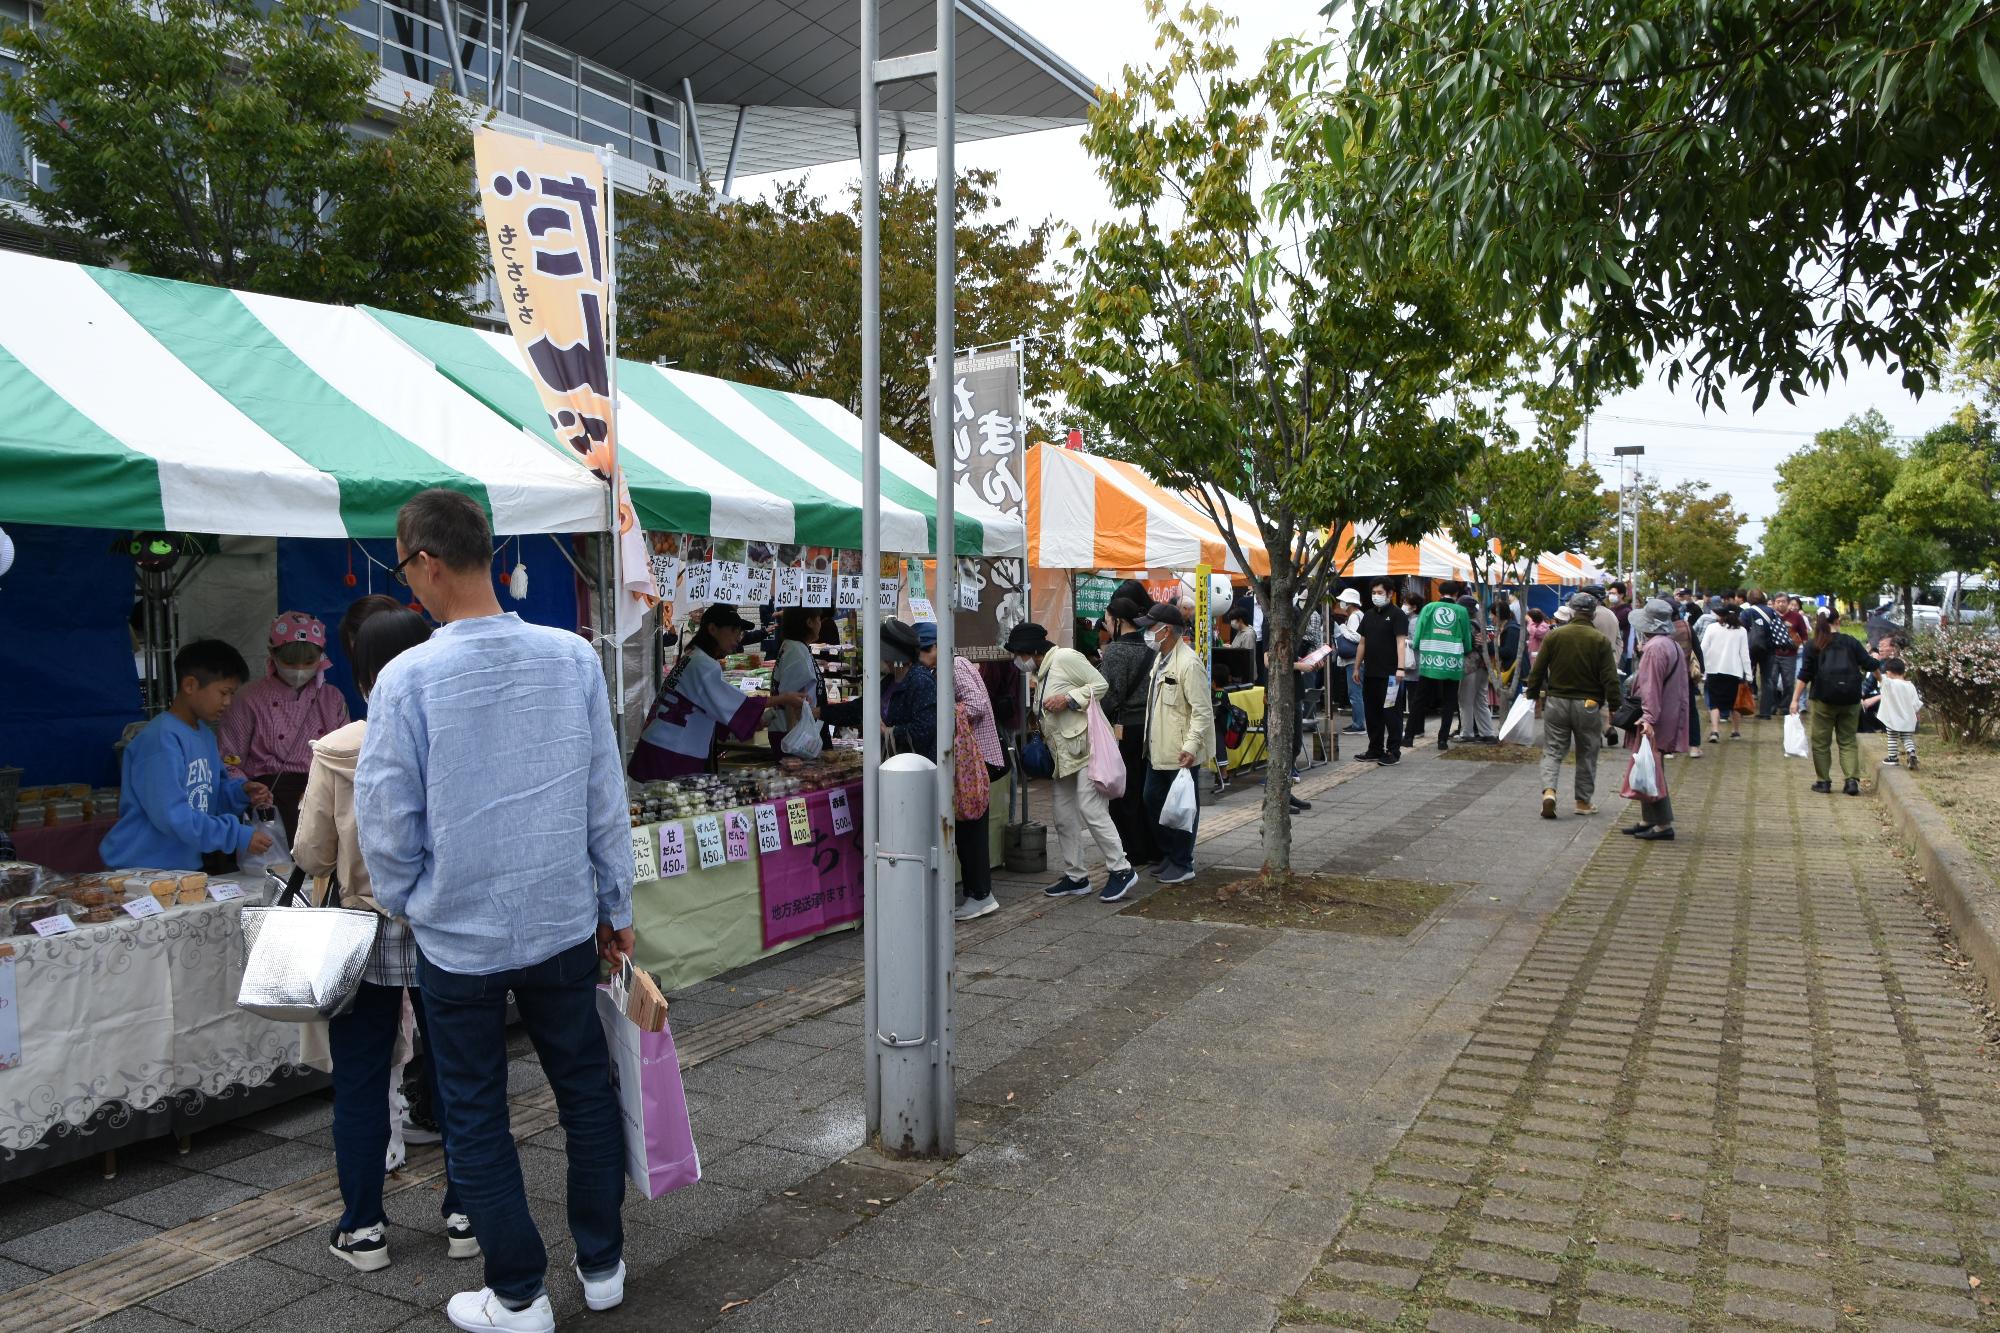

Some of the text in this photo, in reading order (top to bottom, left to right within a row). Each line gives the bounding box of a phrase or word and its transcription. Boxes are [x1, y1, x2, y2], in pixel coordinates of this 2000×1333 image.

[718, 560, 739, 574] ずんだ
[696, 820, 717, 833] ずんだ
[760, 822, 776, 833] だんご
[666, 829, 676, 843] 甘
[700, 835, 719, 848] だんご
[728, 831, 745, 842] だんご
[662, 843, 682, 856] だんご
[662, 859, 685, 874] 450円
